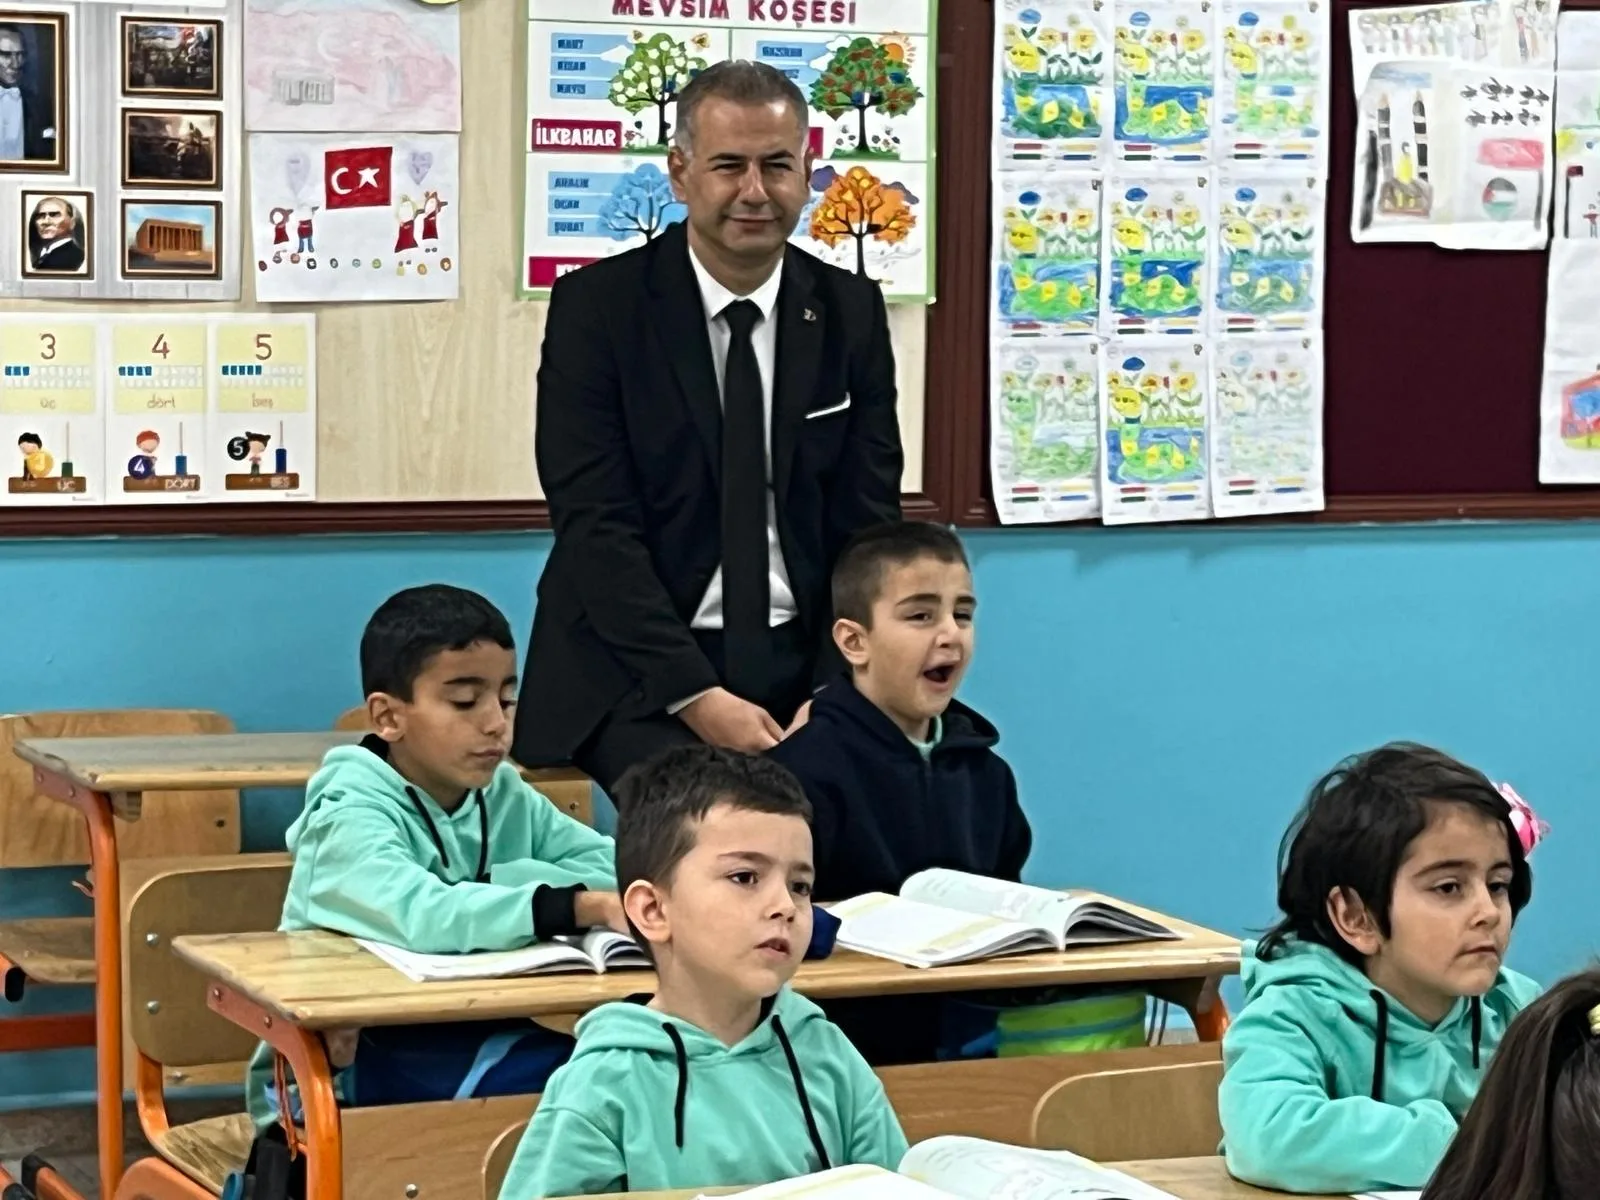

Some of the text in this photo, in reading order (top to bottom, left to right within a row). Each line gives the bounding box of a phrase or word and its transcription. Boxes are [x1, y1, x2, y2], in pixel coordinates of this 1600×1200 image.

[536, 122, 616, 146] İLKBAHAR
[40, 333, 56, 360] 3
[151, 333, 170, 359] 4
[255, 333, 273, 360] 5
[233, 440, 244, 456] 5
[133, 458, 145, 474] 4
